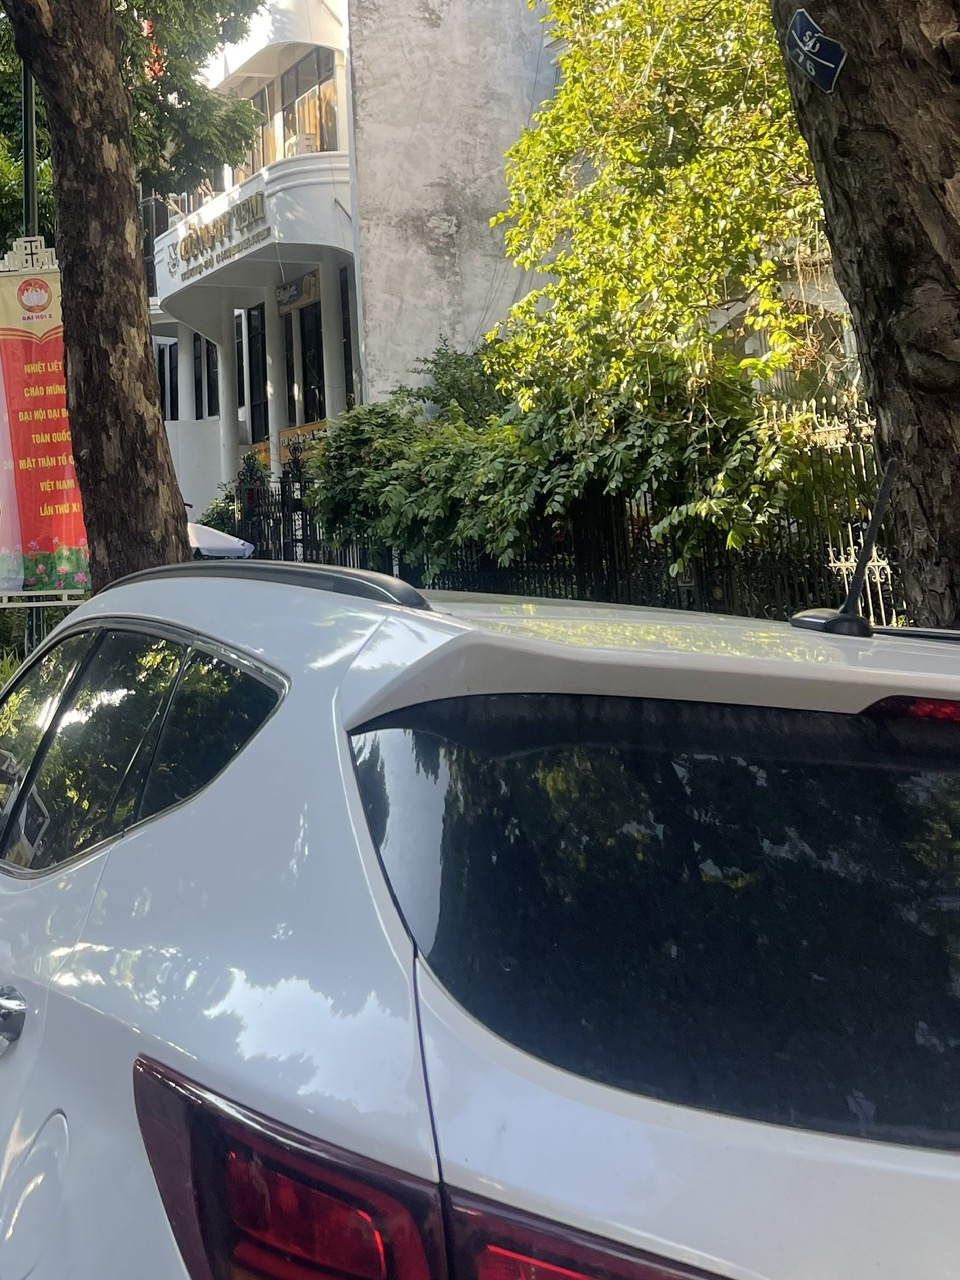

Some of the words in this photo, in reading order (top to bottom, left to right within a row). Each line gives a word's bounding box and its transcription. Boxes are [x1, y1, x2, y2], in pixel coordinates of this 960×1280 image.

[24, 361, 46, 374] NHIỆT
[47, 360, 62, 373] LIỆT
[24, 385, 44, 397] CHÀO
[18, 411, 32, 423] ĐẠI
[34, 408, 46, 421] HỘI
[47, 409, 60, 420] ĐẠI
[31, 432, 51, 444] TOÀN
[52, 429, 71, 443] QUỐC
[19, 457, 36, 471] MẶT
[37, 455, 56, 469] TRẬN
[39, 479, 54, 493] VIỆT
[56, 478, 75, 490] NAM
[39, 502, 54, 516] LẦN
[54, 501, 70, 514] THỨ
